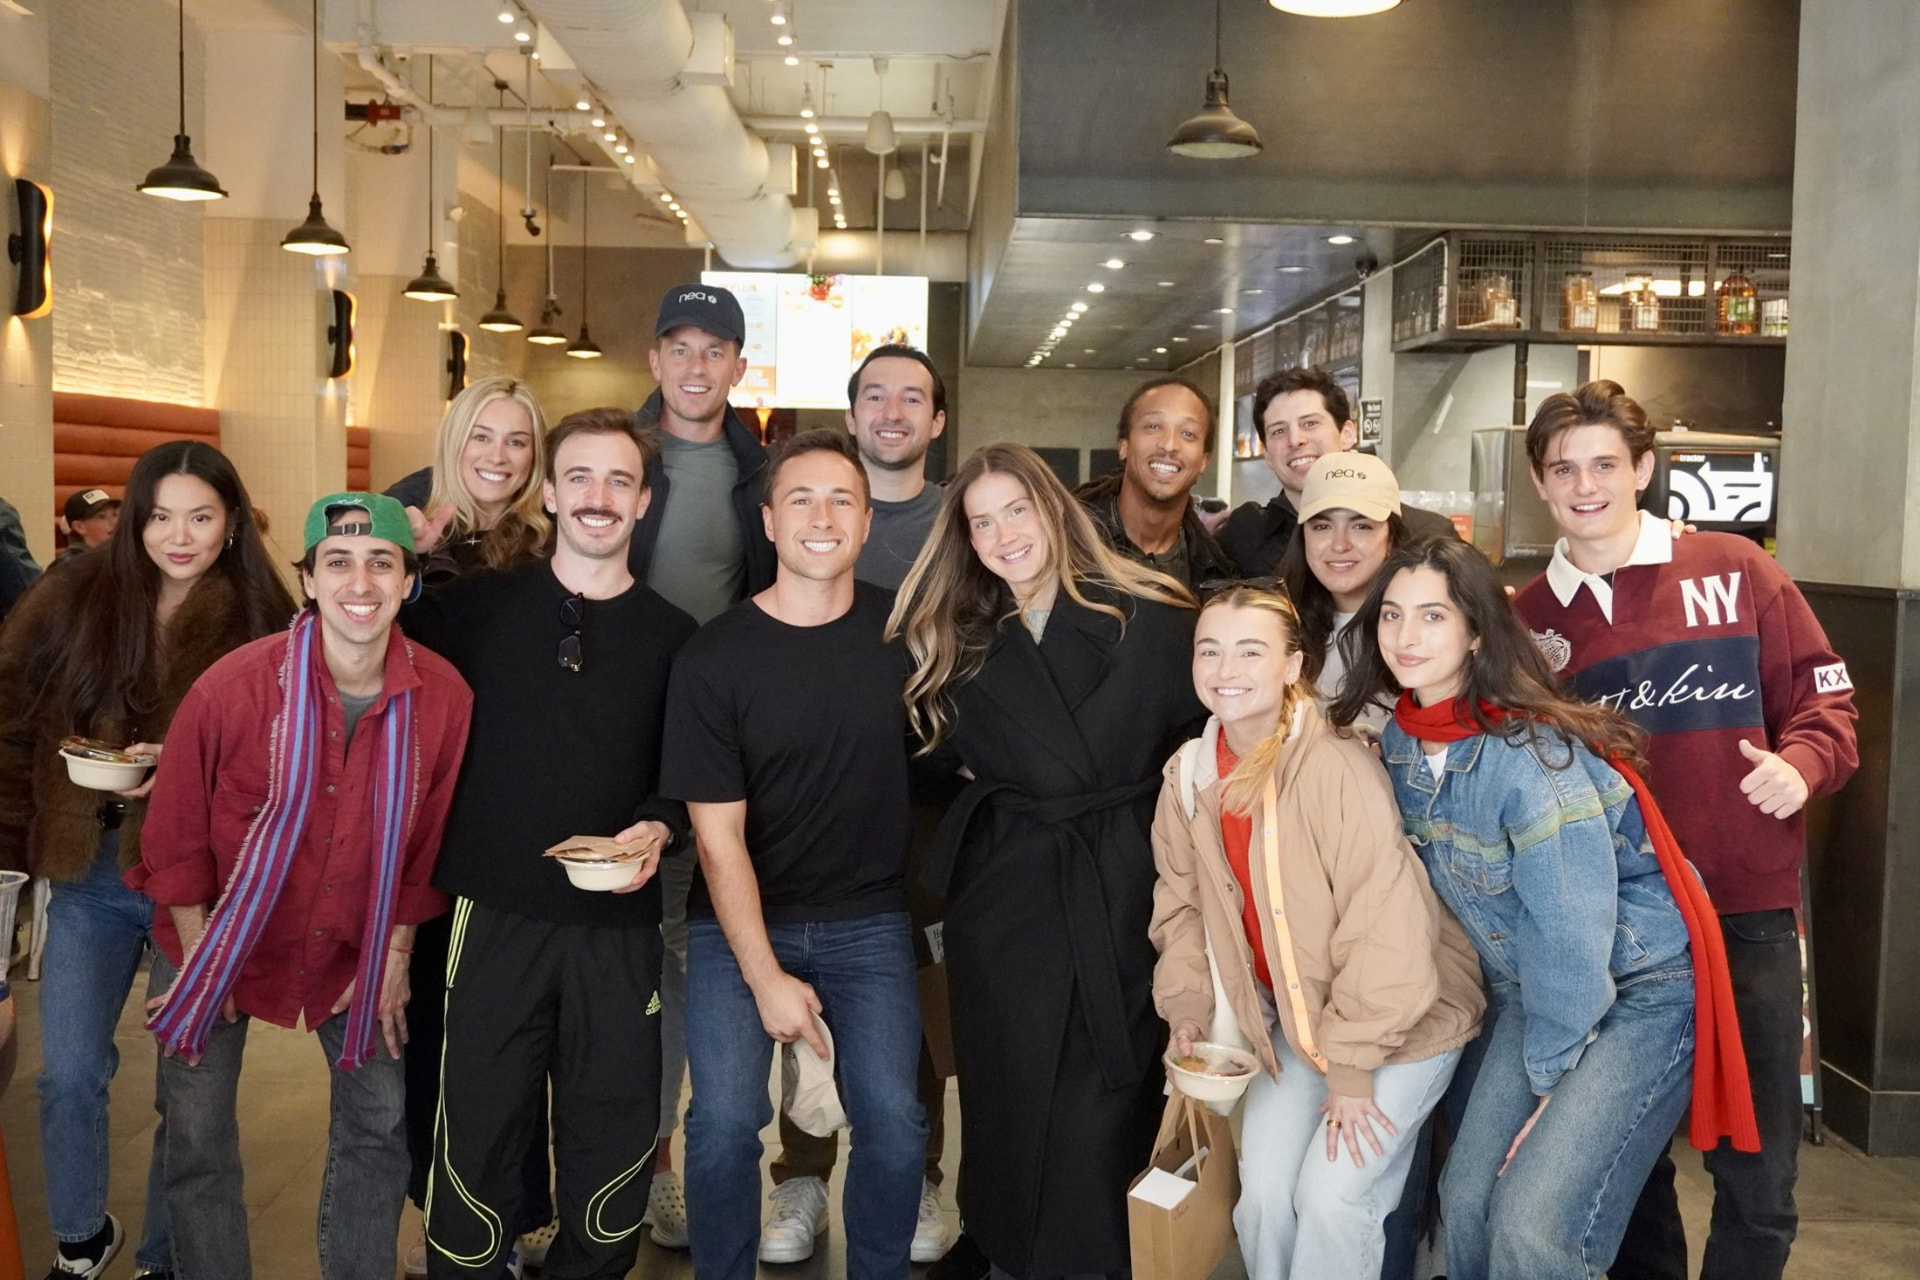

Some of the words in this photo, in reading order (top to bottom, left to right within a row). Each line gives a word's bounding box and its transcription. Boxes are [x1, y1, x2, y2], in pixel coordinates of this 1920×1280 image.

[678, 291, 706, 303] nea
[1325, 468, 1355, 480] nea
[1678, 571, 1742, 628] NY
[1818, 667, 1848, 688] KX
